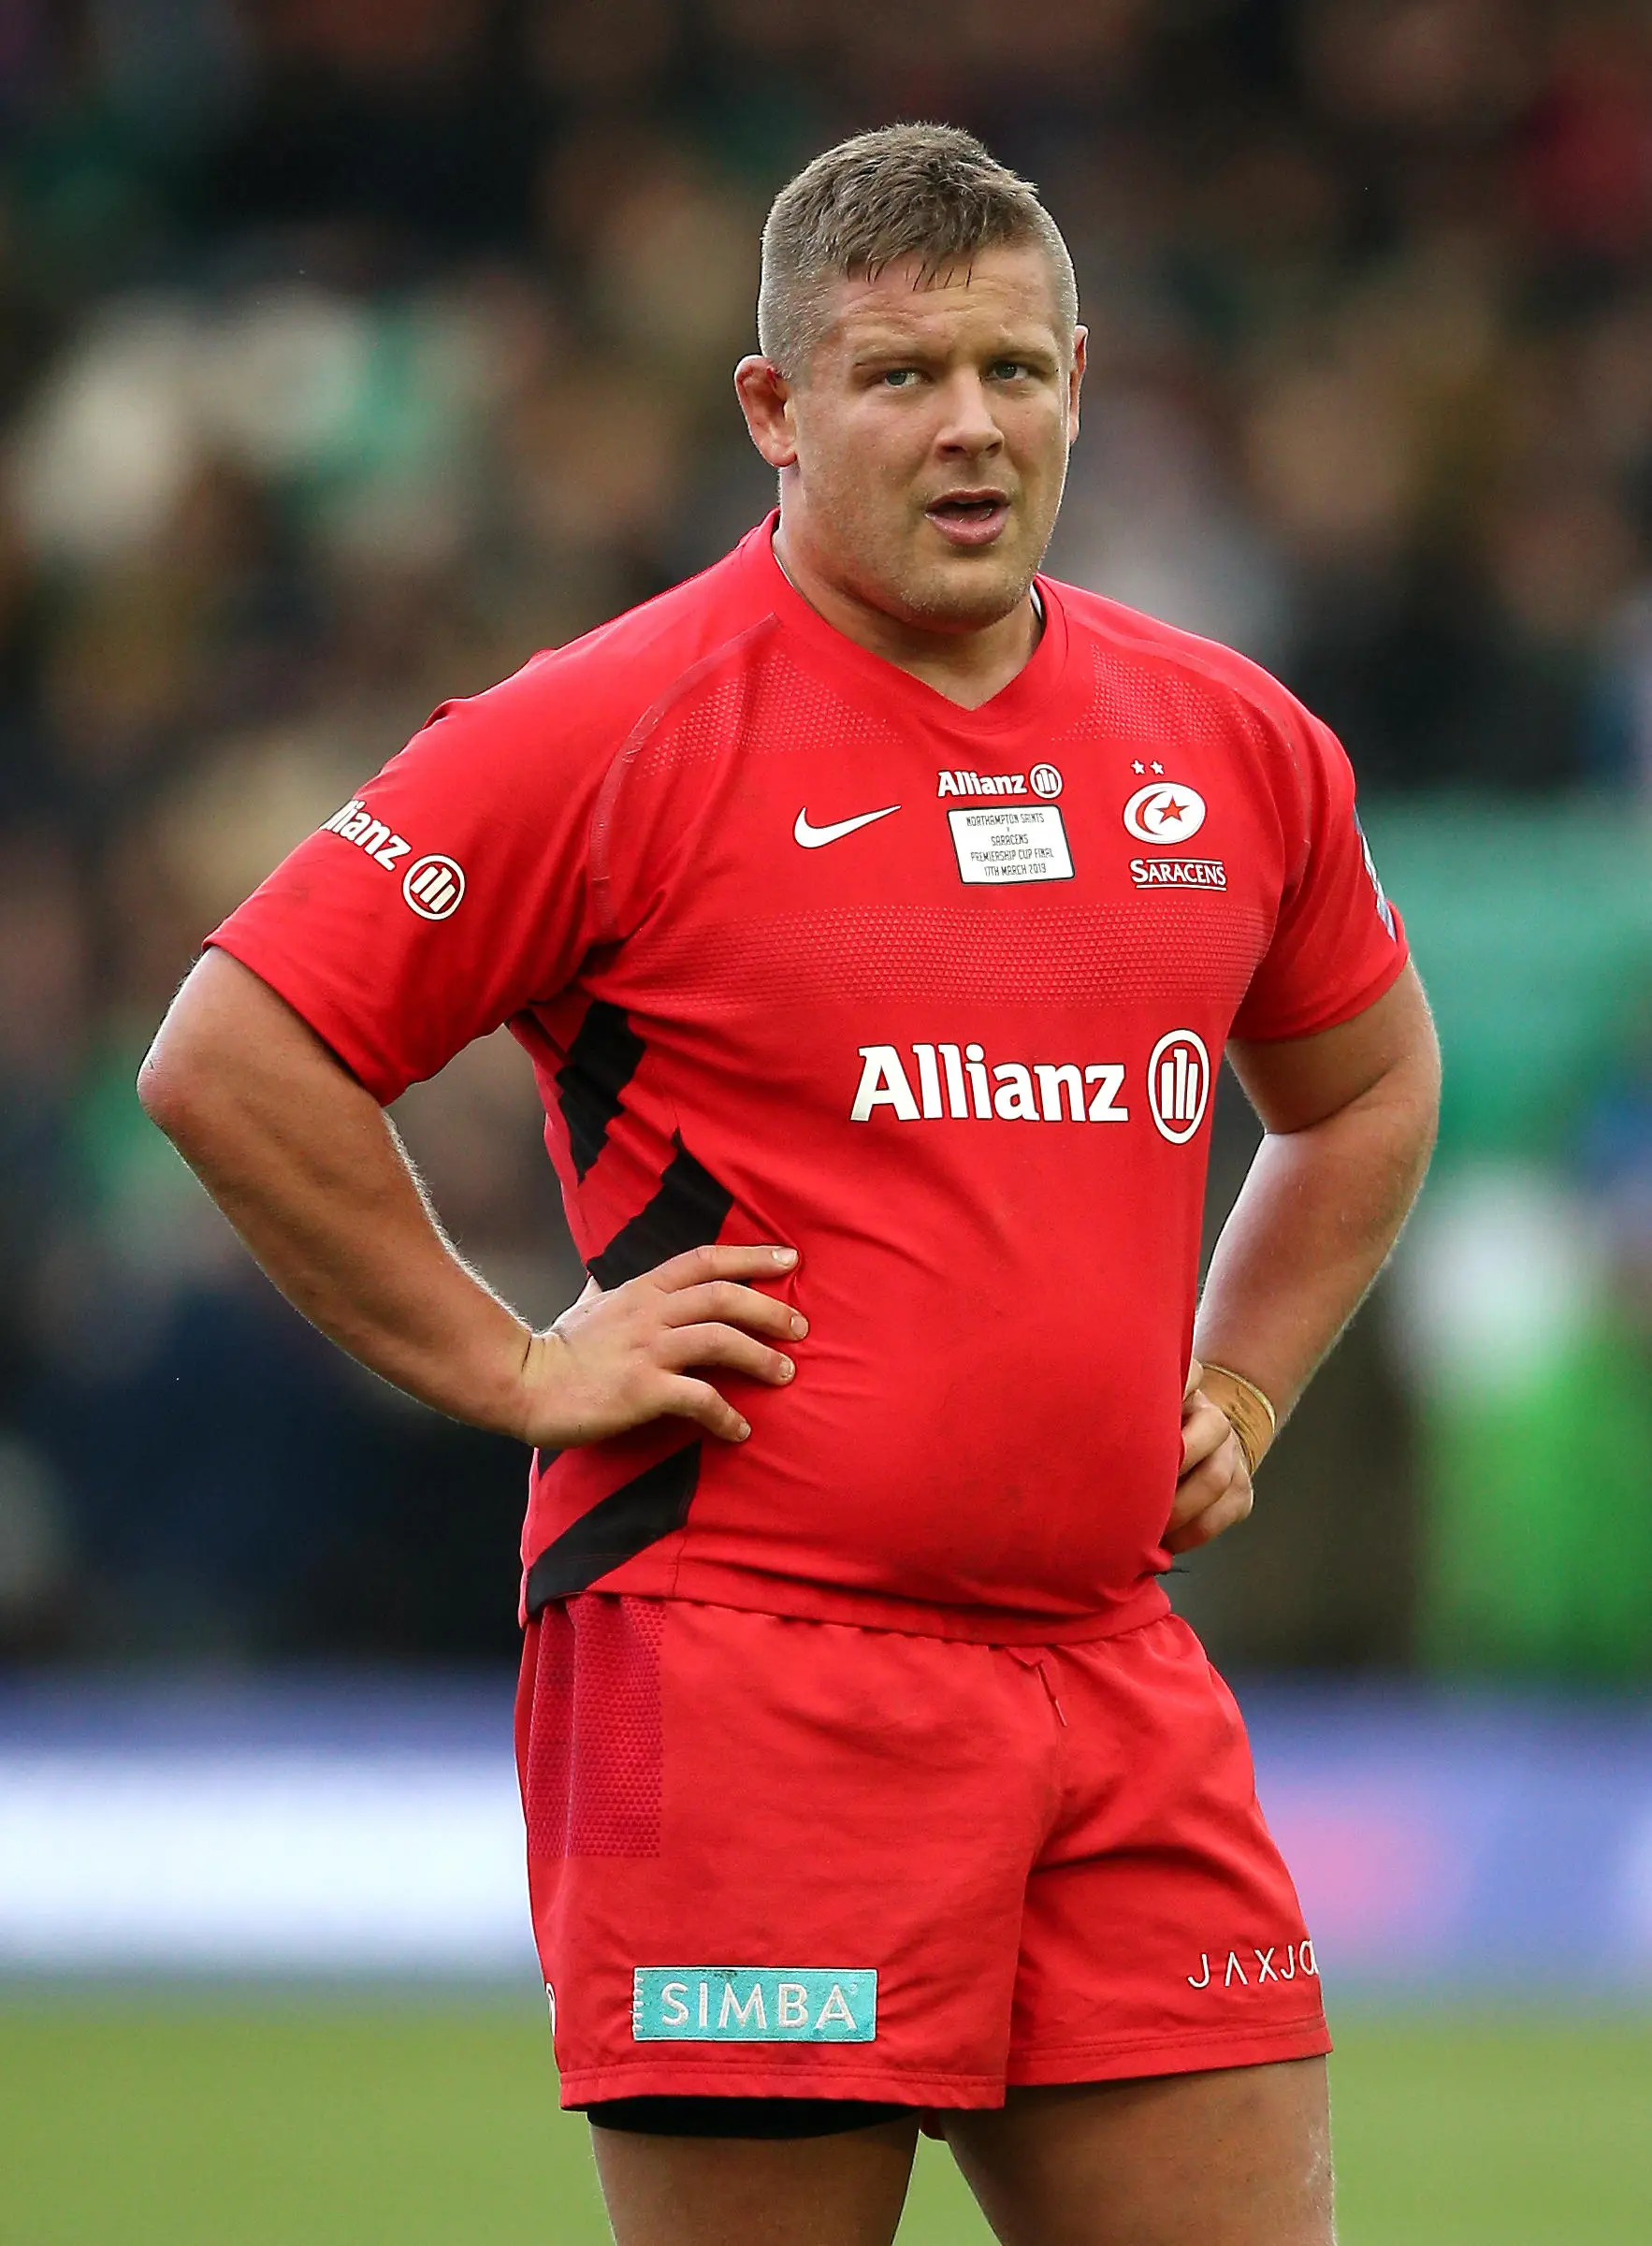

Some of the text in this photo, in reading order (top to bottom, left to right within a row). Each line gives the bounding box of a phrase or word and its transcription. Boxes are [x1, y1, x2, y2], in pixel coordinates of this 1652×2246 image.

[936, 770, 1028, 798] Allianz
[965, 812, 1045, 826] NORTHAMPTON SAINTS
[991, 833, 1029, 847] SARACENS
[970, 848, 1054, 862] PREMIERSHIP CUP FINAL
[1001, 864, 1027, 877] MARCH
[1129, 859, 1227, 887] SARACENS
[849, 1041, 1130, 1123] Allianz
[659, 1980, 859, 2031] SIMBA
